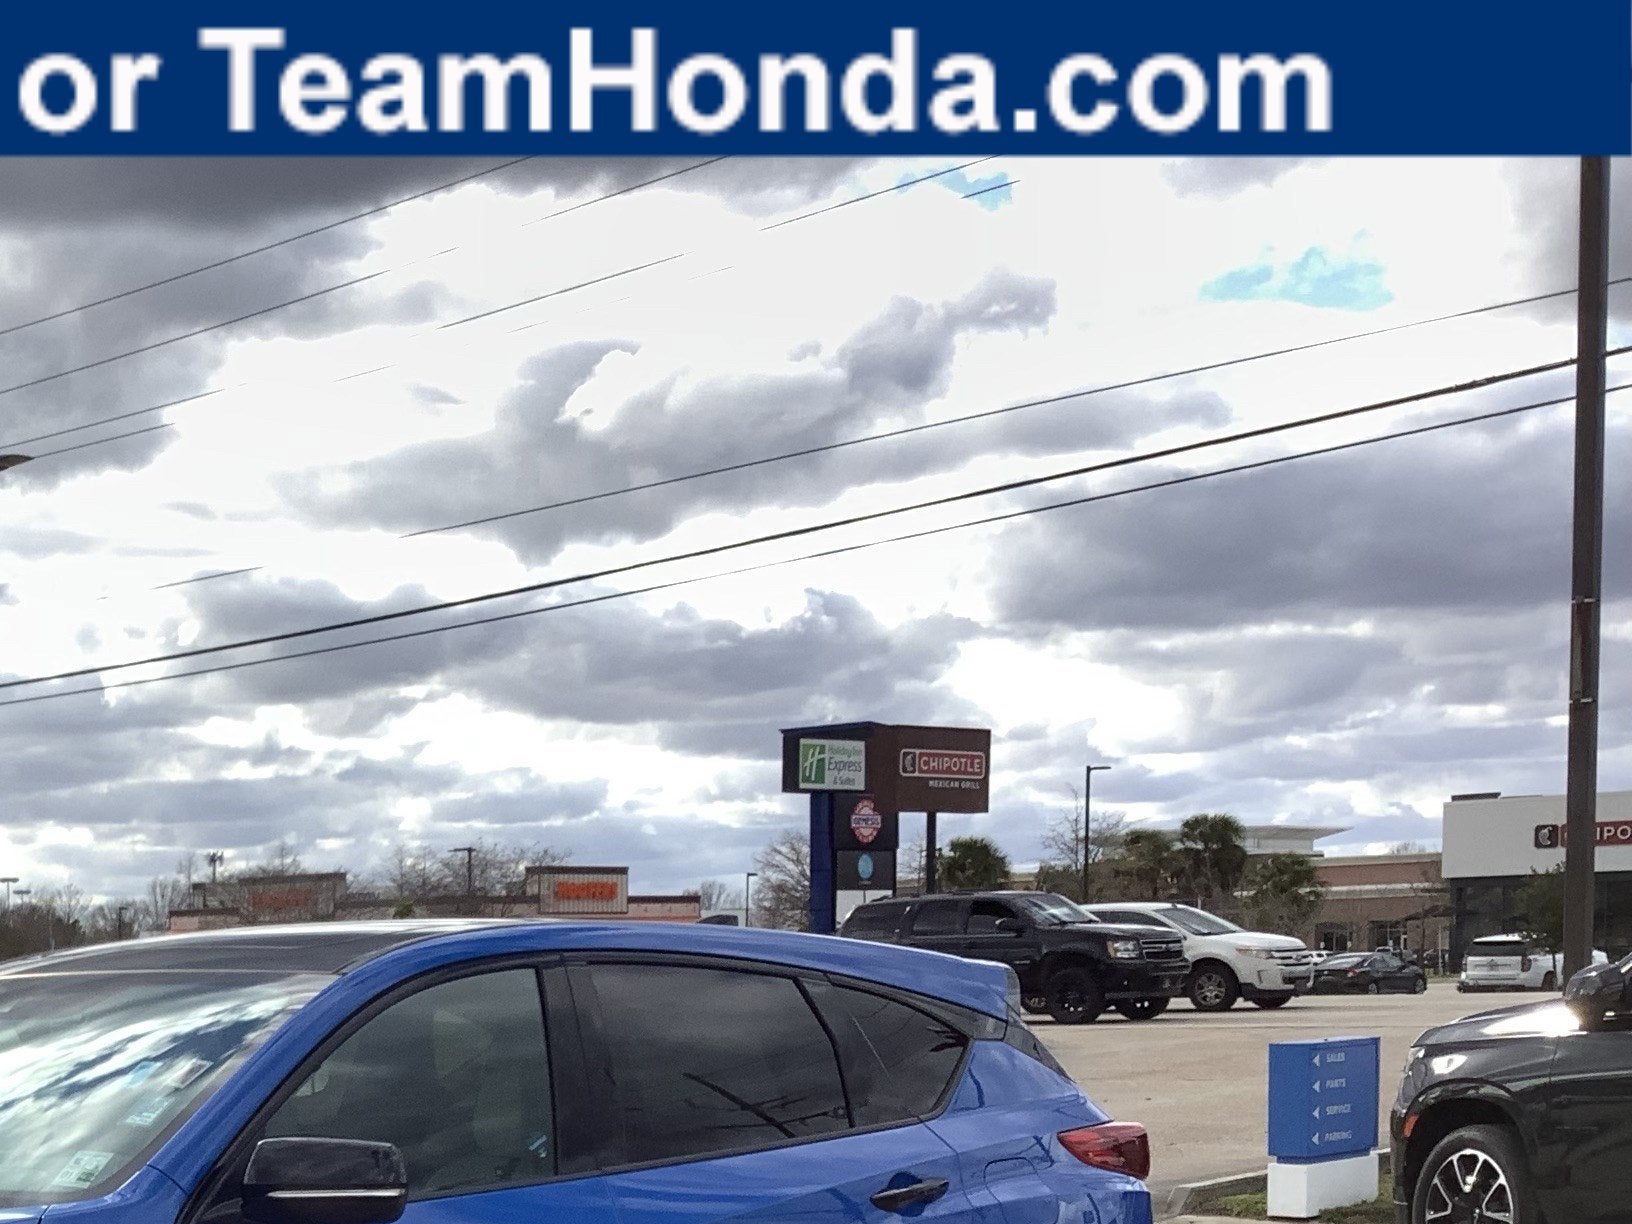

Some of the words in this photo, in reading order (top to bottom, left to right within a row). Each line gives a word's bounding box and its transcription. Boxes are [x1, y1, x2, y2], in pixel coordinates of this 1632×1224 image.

[828, 756, 863, 774] Express
[920, 756, 981, 773] CHIPOTLE
[928, 780, 960, 788] MEXICAN
[961, 781, 980, 789] GRILL
[1326, 1052, 1346, 1062] SALES
[1325, 1078, 1347, 1089] PARTS
[1326, 1104, 1352, 1115] SERVICE
